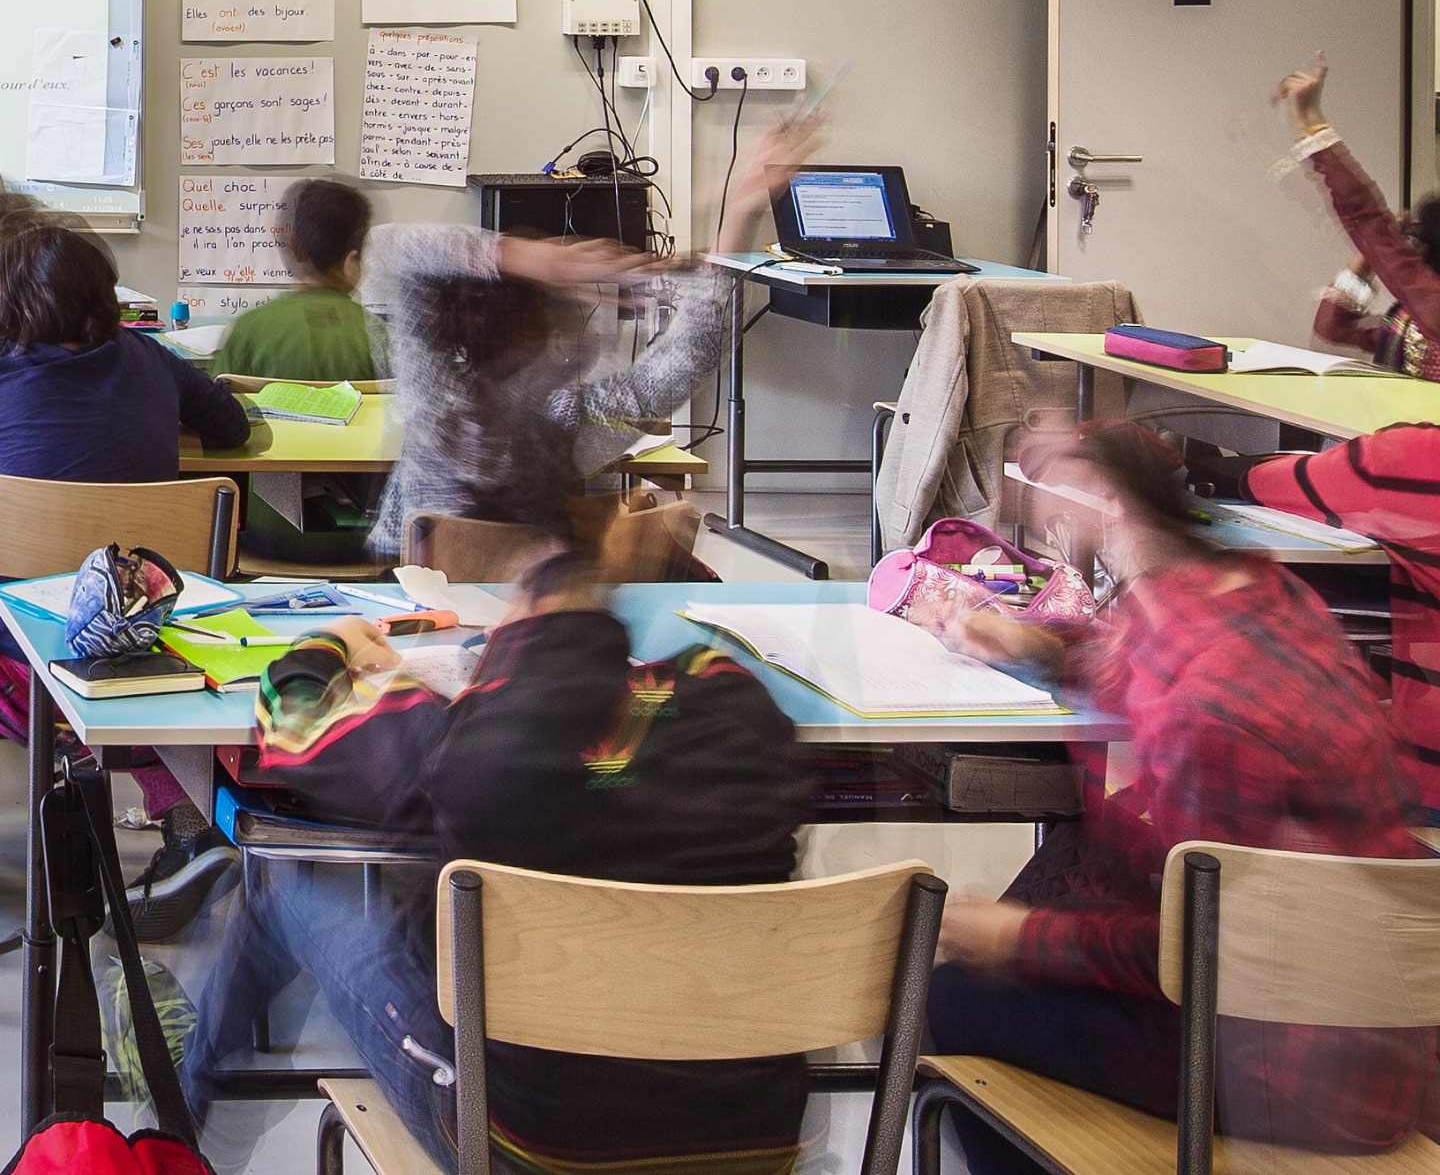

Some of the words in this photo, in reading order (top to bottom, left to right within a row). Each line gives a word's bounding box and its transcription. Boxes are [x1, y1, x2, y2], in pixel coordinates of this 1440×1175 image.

[183, 61, 220, 79] C'est
[231, 63, 246, 77] les
[29, 79, 70, 91] d'eux.
[183, 97, 206, 112] Ces
[214, 100, 254, 116] garçons
[261, 97, 282, 109] sont
[183, 179, 213, 193] Quel
[224, 182, 258, 193] choc
